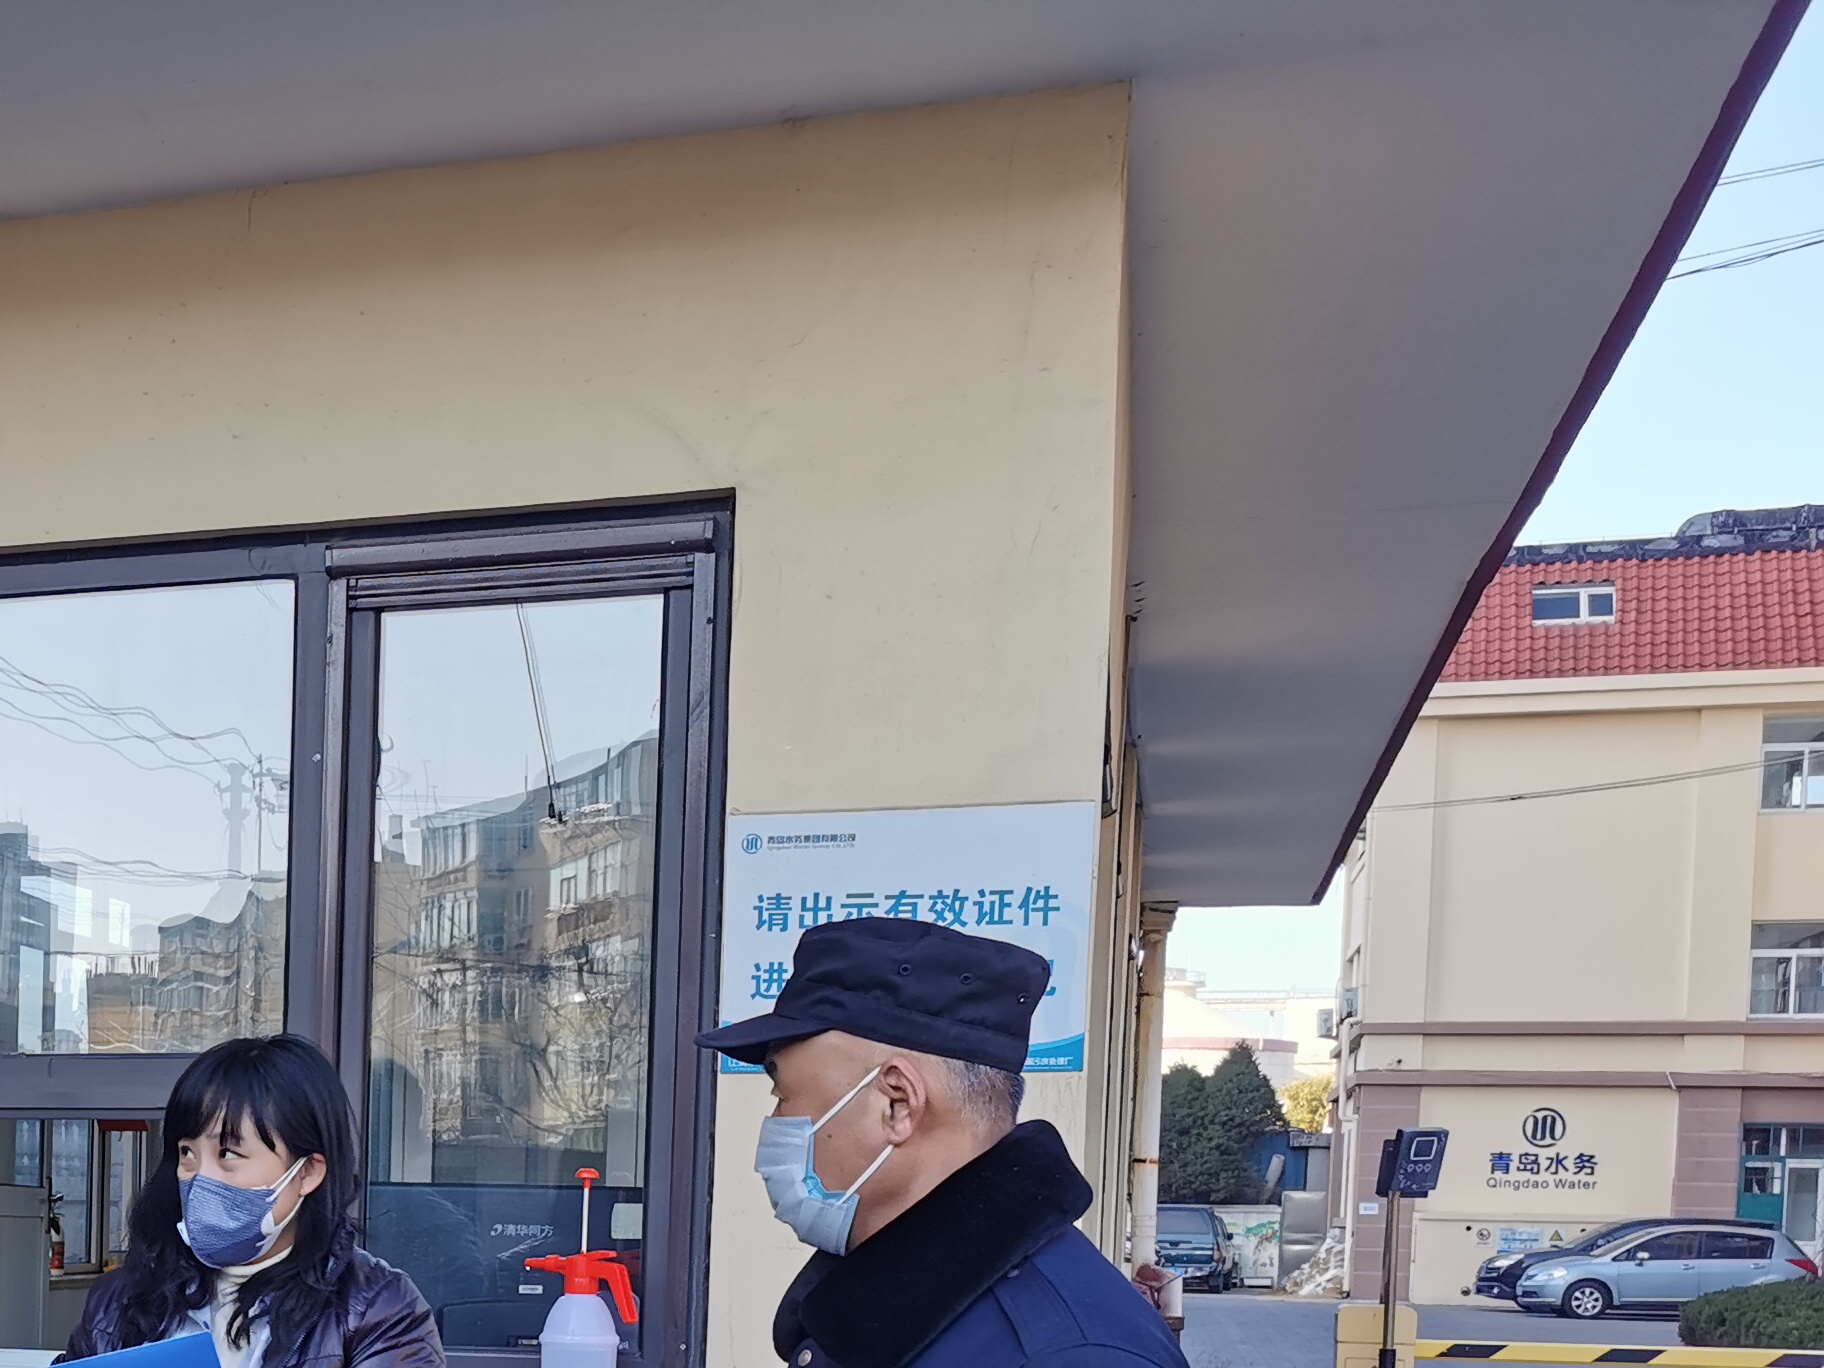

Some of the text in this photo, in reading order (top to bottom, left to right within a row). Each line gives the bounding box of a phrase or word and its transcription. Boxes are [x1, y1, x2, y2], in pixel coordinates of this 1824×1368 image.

[752, 885, 1061, 932] 请出示有效证件
[1489, 1151, 1598, 1176] 青岛水务
[1486, 1177, 1598, 1191] Qingdao Water
